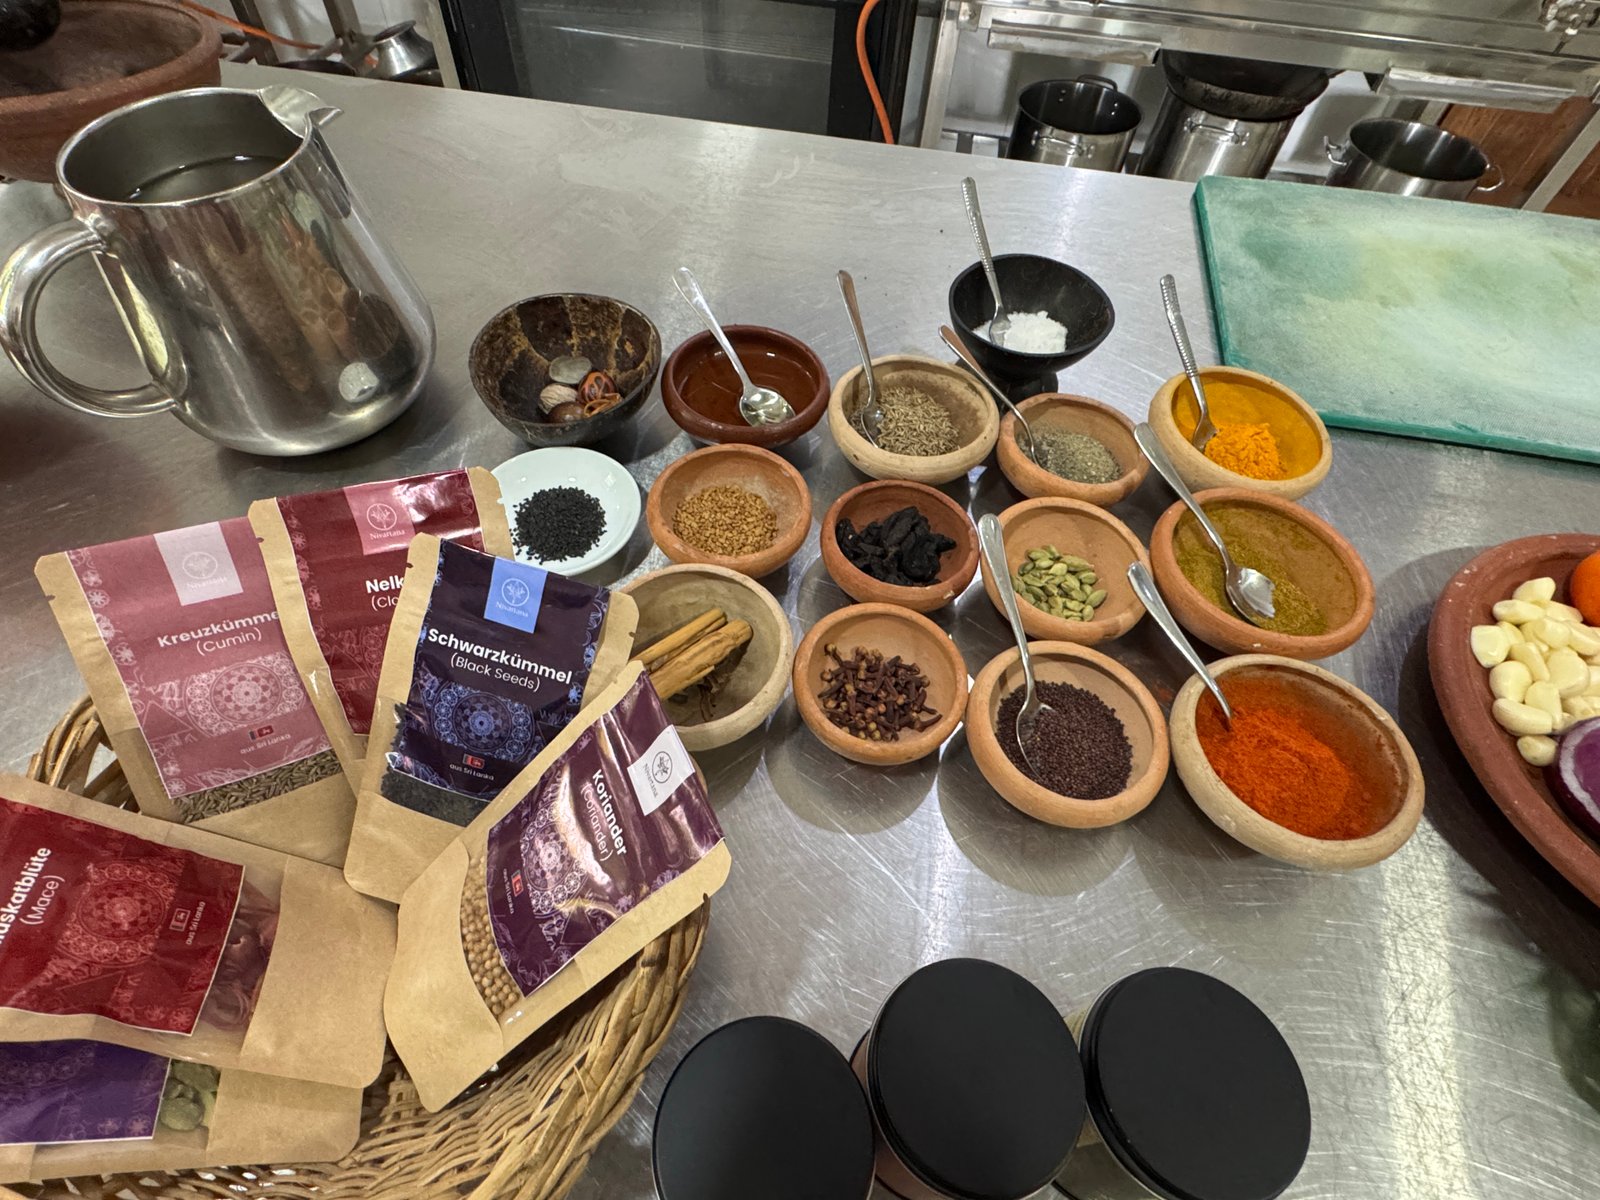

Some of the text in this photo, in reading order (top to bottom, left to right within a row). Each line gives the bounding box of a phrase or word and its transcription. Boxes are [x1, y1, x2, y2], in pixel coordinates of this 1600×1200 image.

[365, 575, 404, 594] Nelk
[371, 595, 399, 611] (Clo
[157, 610, 280, 648] Kreuzkümme
[197, 627, 262, 656] (Cumin)
[428, 628, 573, 685] Schwarzkümmel
[450, 652, 541, 692] (Black Seeds)
[240, 734, 291, 754] aus Sri Lanka
[449, 763, 495, 781] aus Sri Lanka
[580, 782, 614, 861] (Coriander)
[592, 768, 627, 855] Koriander
[19, 875, 65, 925] (Mace)
[507, 891, 515, 914] Lanka
[186, 901, 206, 945] aus Sri Lanka
